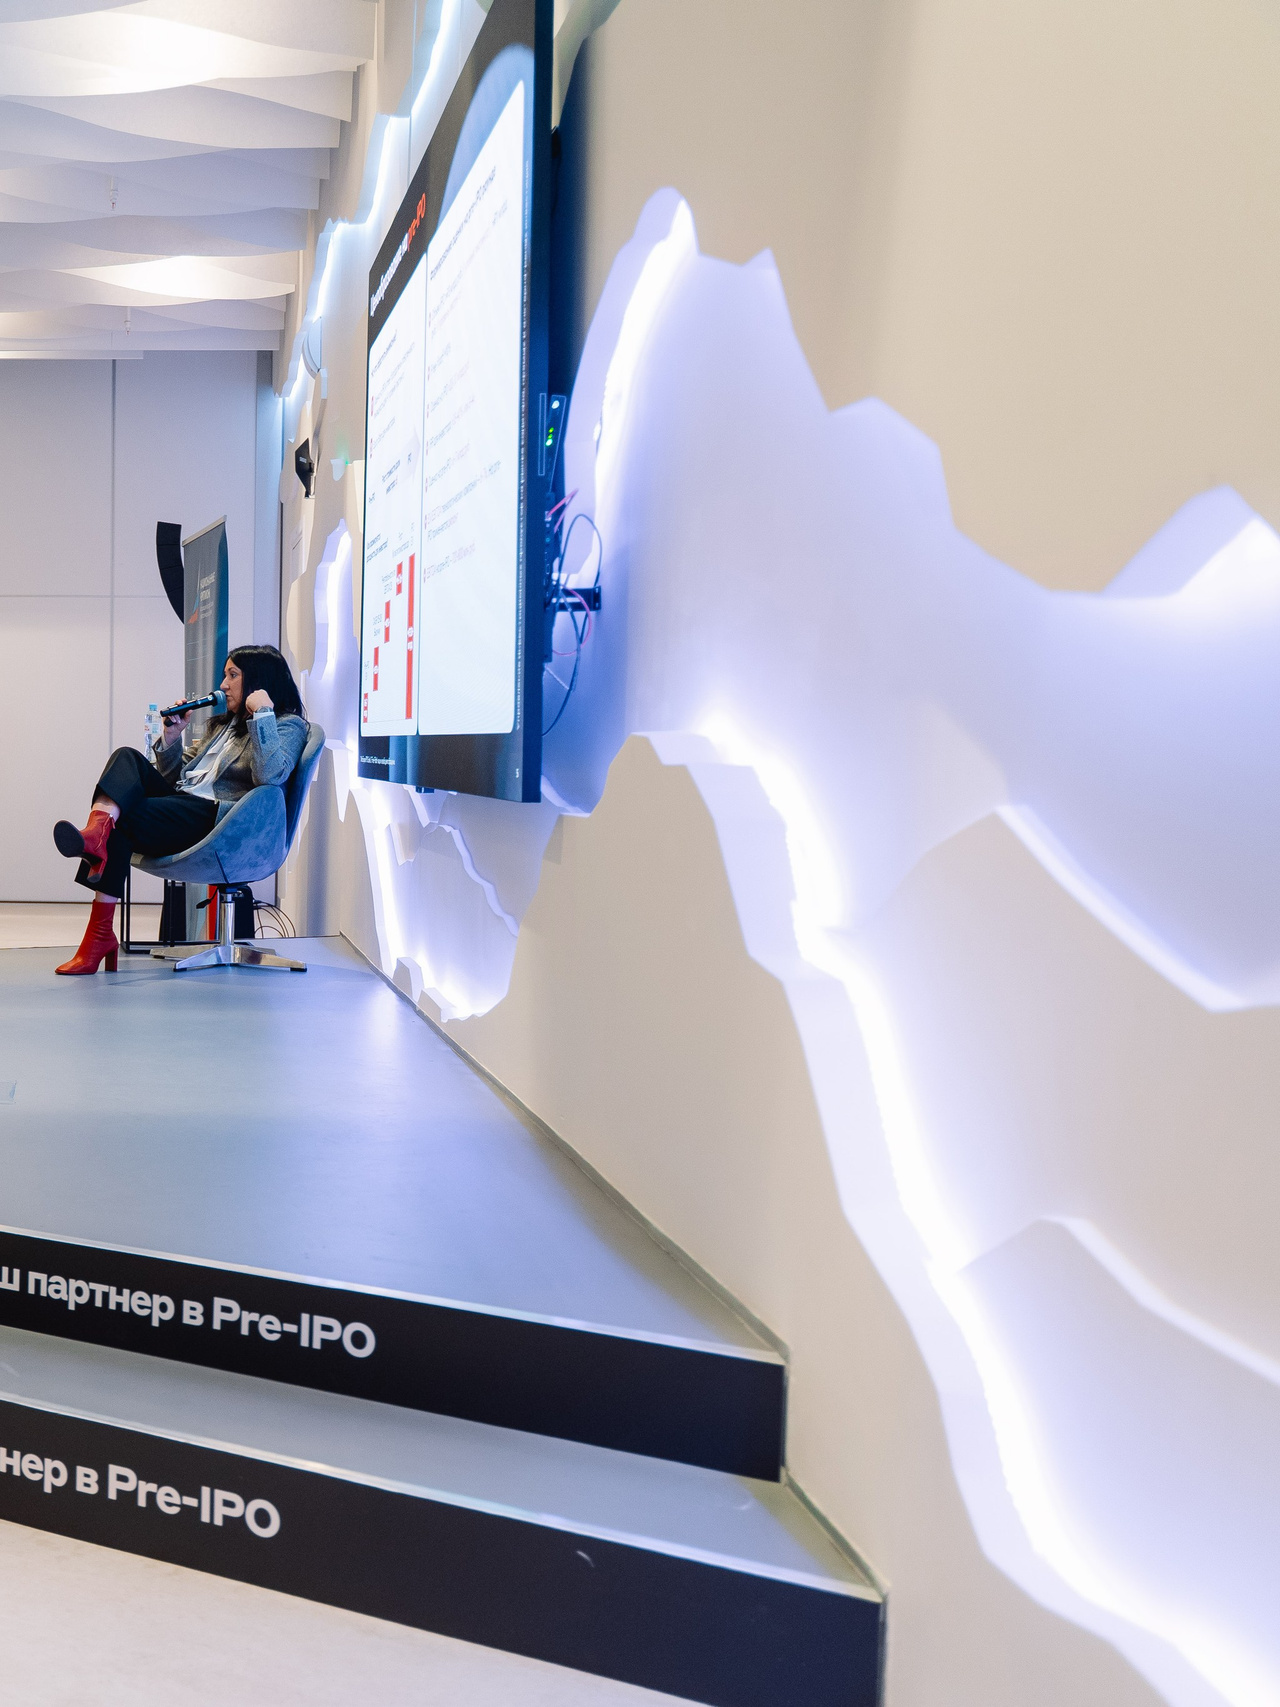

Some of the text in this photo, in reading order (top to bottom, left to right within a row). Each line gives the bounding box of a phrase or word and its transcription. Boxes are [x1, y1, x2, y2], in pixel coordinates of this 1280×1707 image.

[27, 1271, 175, 1327] партнер
[182, 1300, 204, 1326] в
[212, 1296, 376, 1358] Pre-IPO
[75, 1466, 99, 1495] в
[107, 1463, 281, 1539] Pre-IPO
